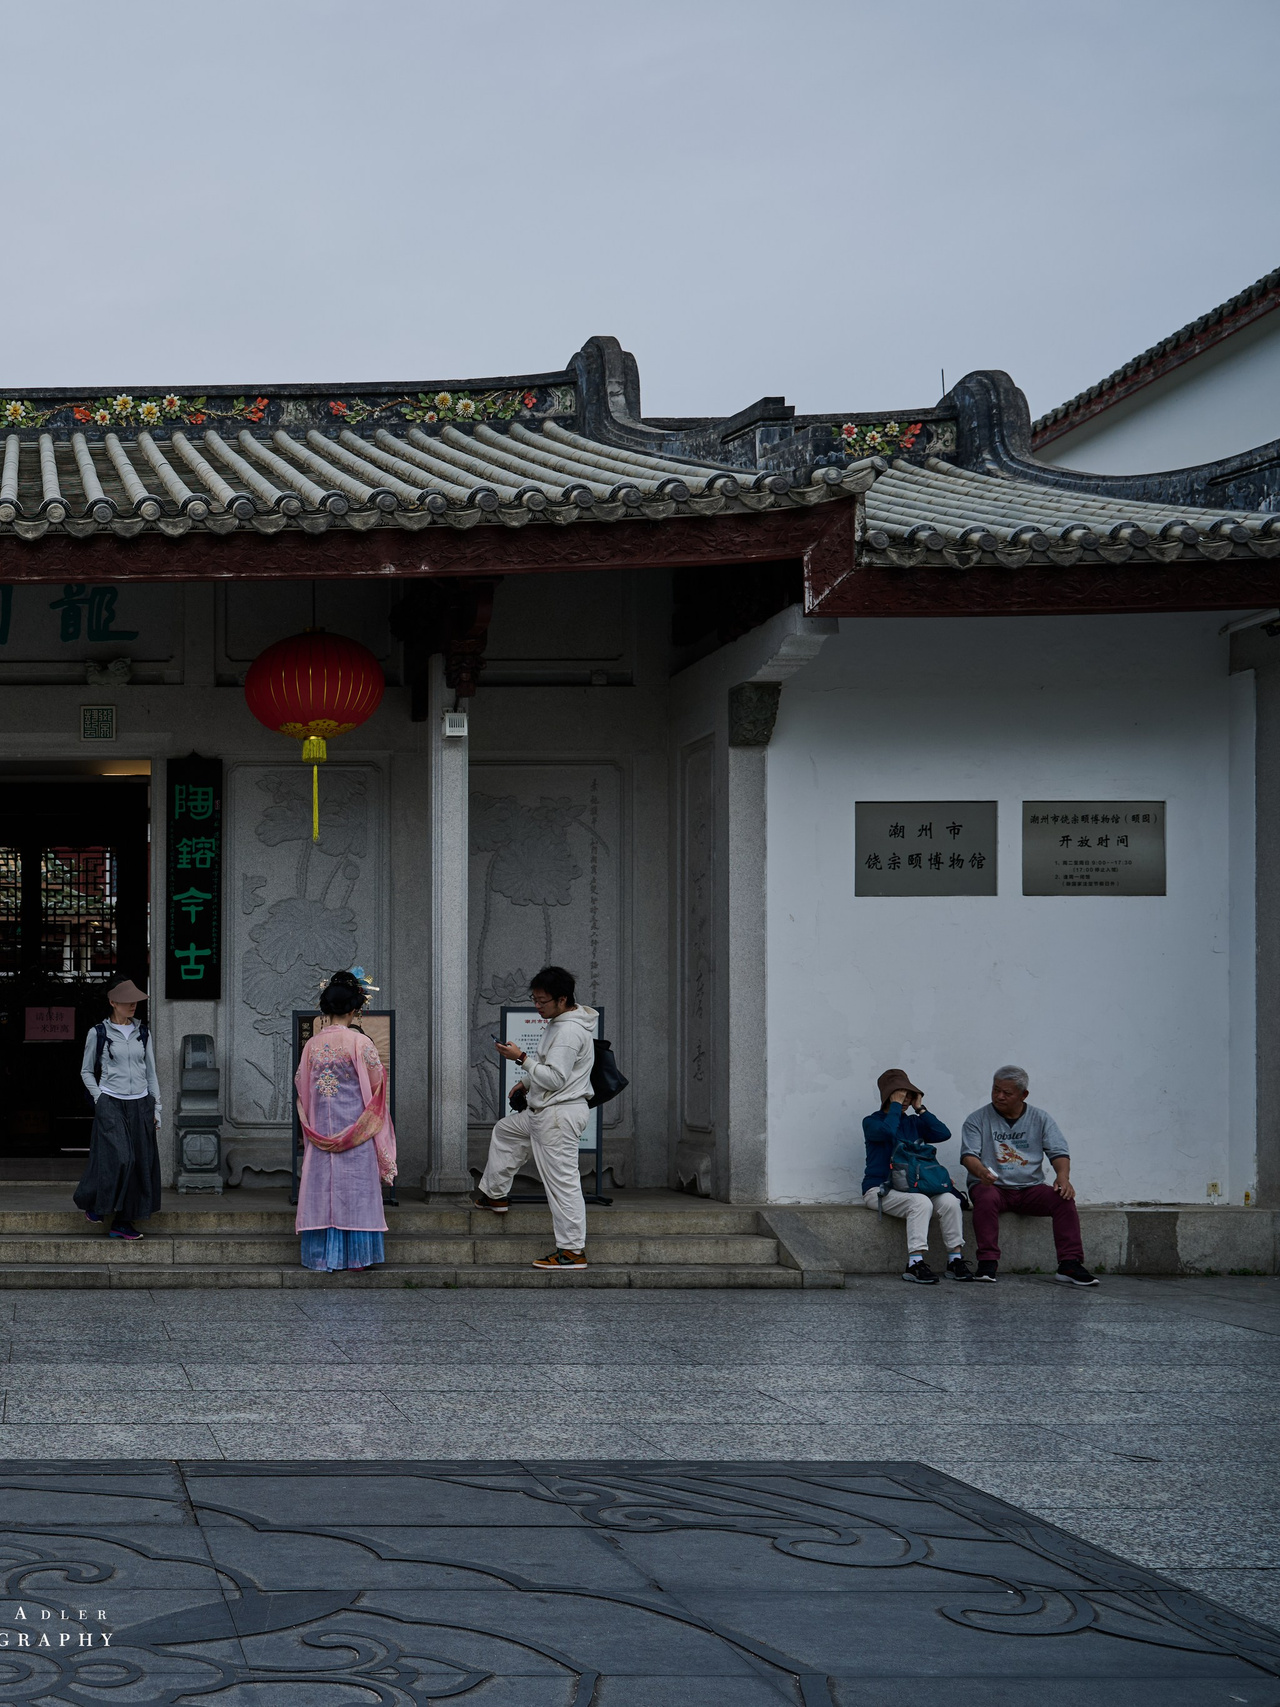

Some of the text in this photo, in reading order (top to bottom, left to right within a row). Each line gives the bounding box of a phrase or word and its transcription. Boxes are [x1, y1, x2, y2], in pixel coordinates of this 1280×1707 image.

[888, 821, 963, 840] 潮州市
[1058, 834, 1129, 848] 开放时间
[864, 851, 987, 871] 饶宗颐博物馆
[29, 1024, 69, 1033] 一米距离
[992, 1131, 1026, 1143] Lobster
